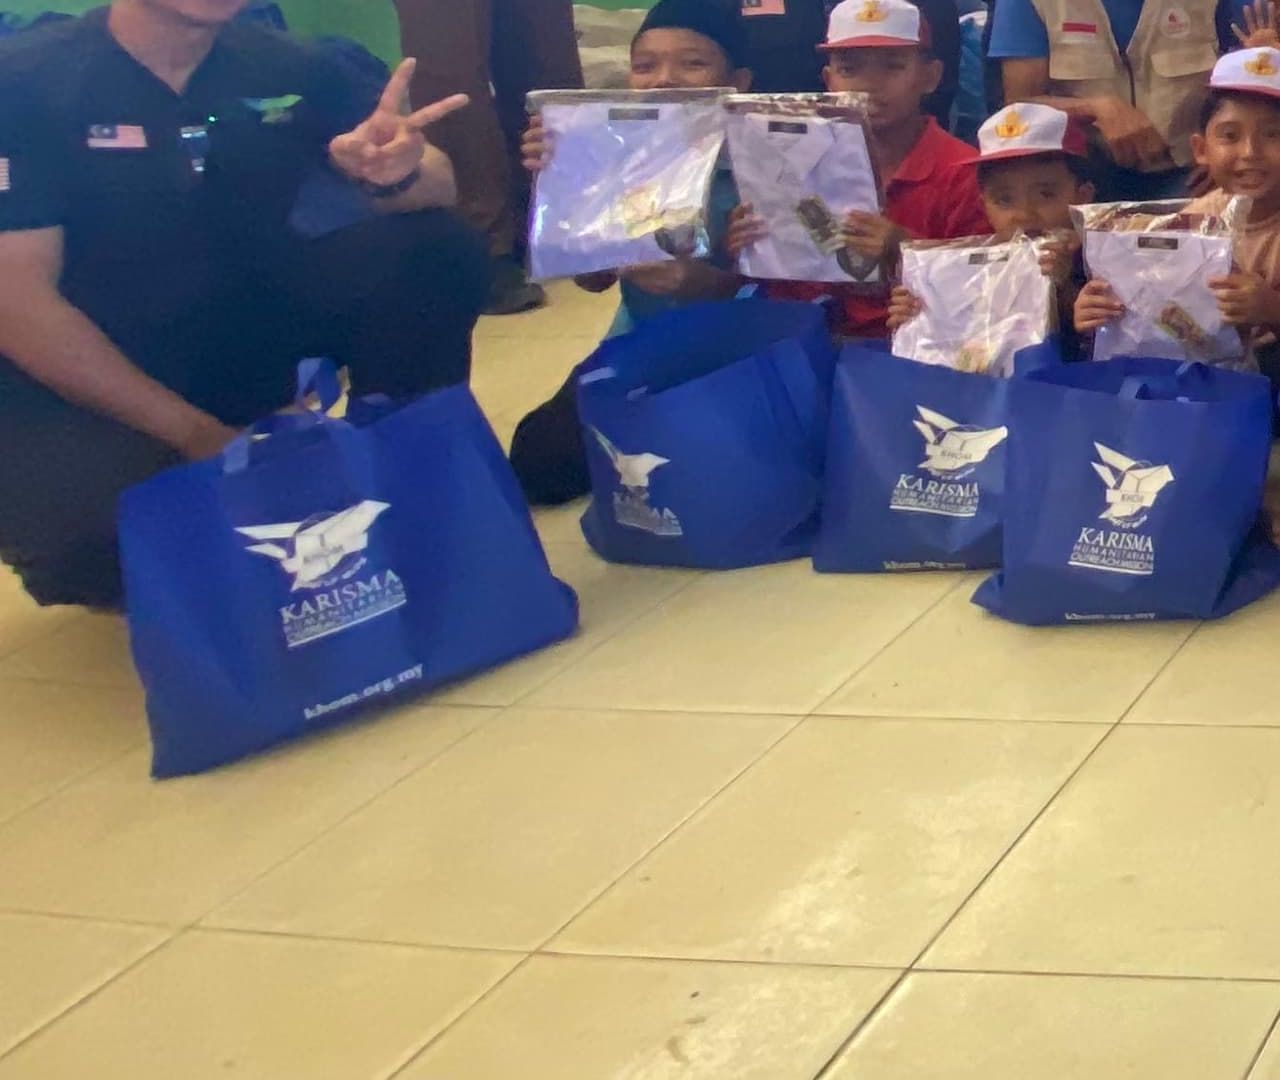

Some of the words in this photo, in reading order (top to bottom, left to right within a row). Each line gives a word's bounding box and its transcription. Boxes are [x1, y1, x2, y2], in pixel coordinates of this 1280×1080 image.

[896, 473, 979, 497] KARISMA
[1078, 527, 1153, 552] KARISMA
[279, 568, 400, 624] KARISMA
